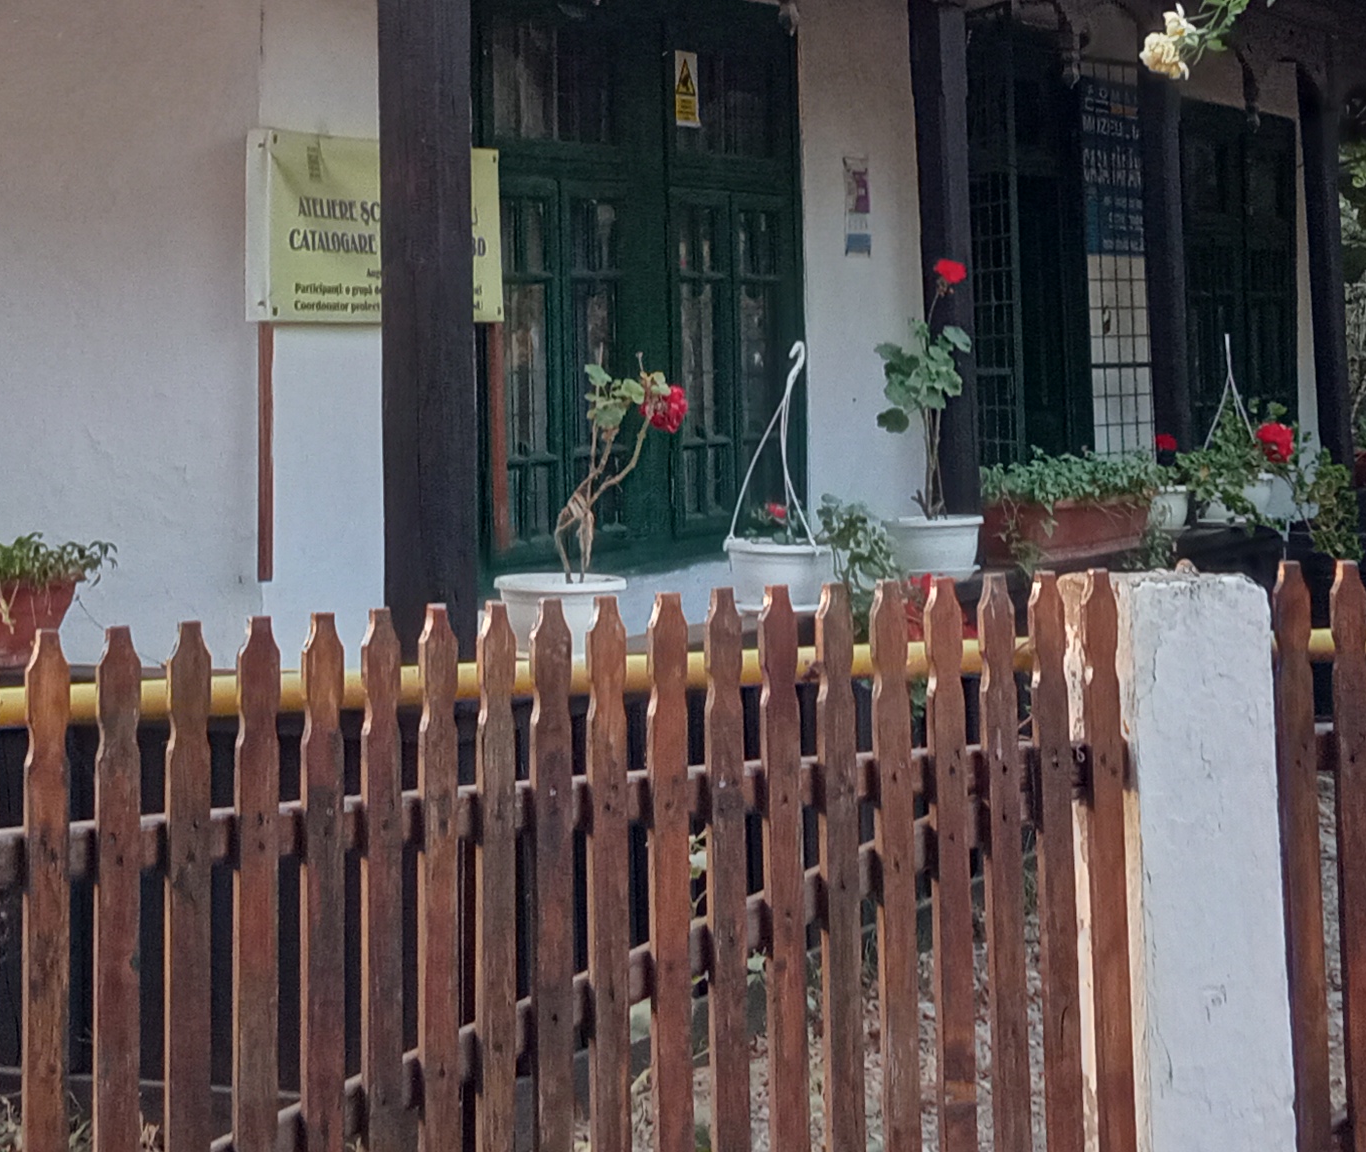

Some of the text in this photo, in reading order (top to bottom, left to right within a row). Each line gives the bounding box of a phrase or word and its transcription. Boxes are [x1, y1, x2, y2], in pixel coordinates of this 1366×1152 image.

[297, 196, 358, 222] ATELIERE
[289, 228, 377, 255] CATALOGARE
[294, 300, 349, 312] Coordonator
